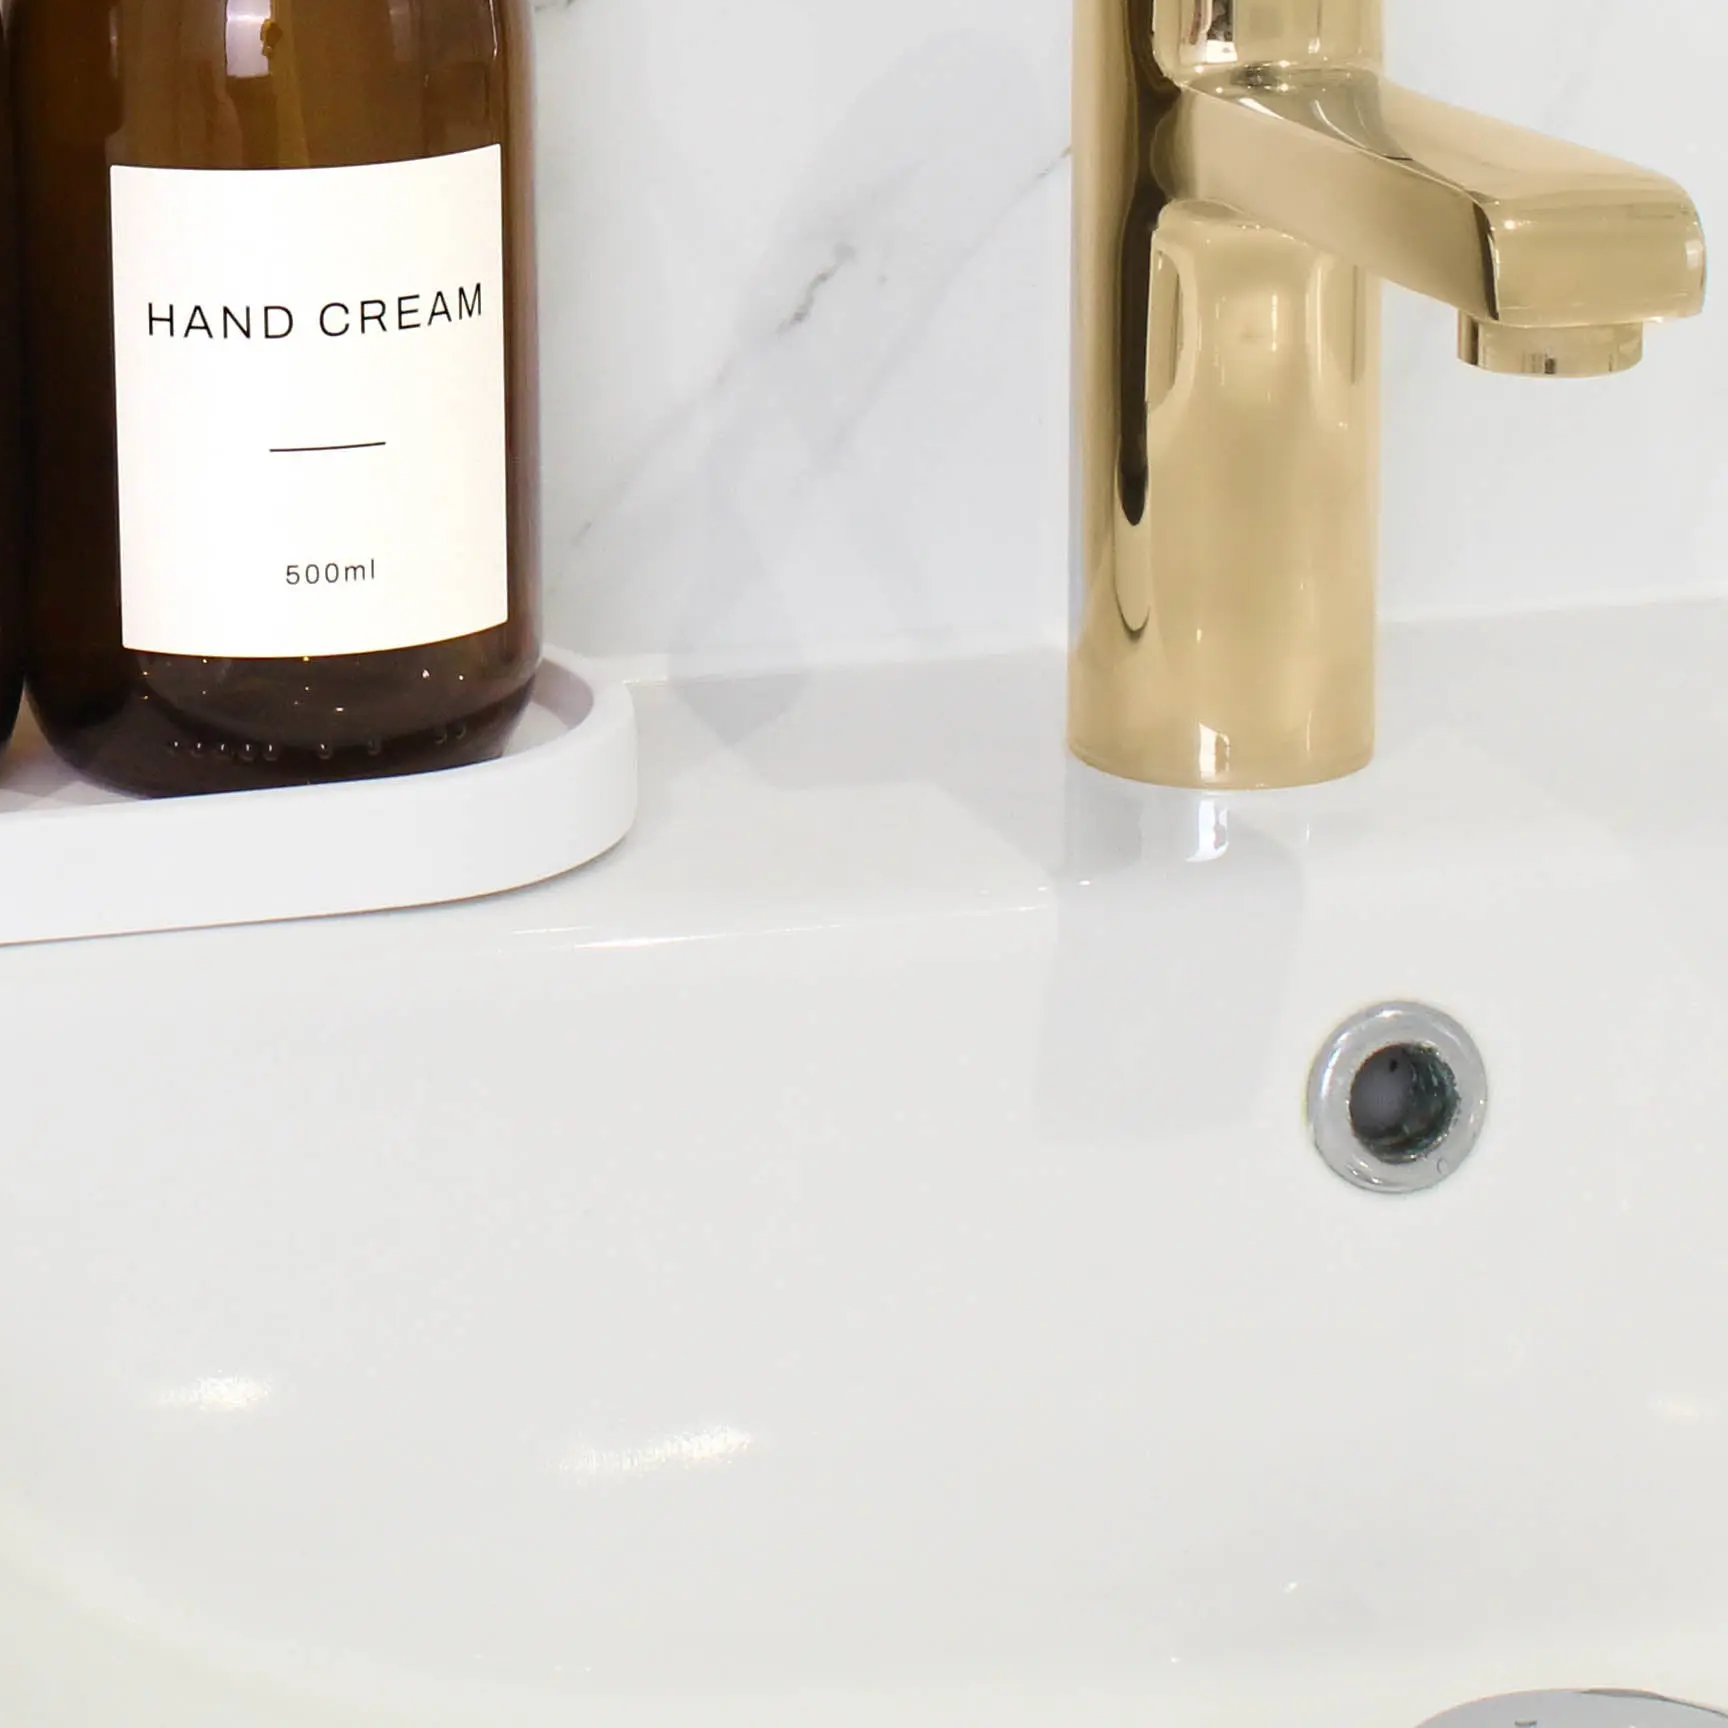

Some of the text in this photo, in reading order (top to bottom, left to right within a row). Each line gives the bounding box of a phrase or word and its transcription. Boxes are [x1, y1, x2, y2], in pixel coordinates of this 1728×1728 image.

[147, 282, 483, 340] HAND CREAM
[286, 559, 376, 586] 500ml
